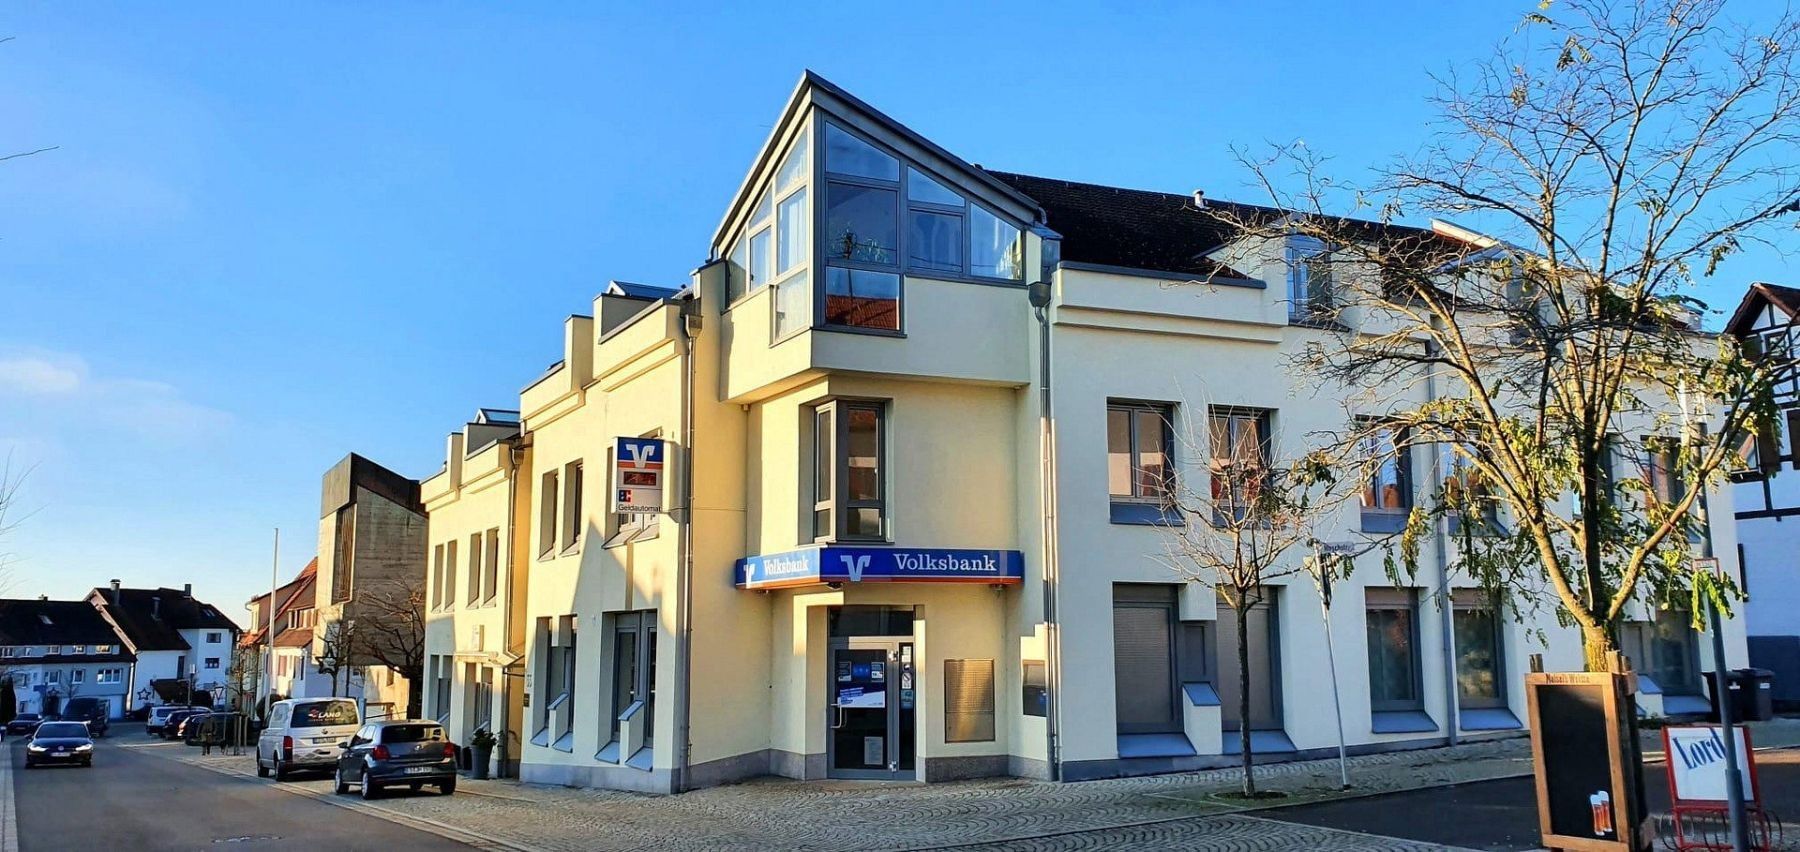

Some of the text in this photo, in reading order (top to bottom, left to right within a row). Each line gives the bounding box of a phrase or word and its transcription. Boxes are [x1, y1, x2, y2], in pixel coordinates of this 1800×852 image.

[618, 503, 661, 512] Geldautomat
[763, 556, 809, 575] Volksbank
[893, 553, 997, 571] Volksbank
